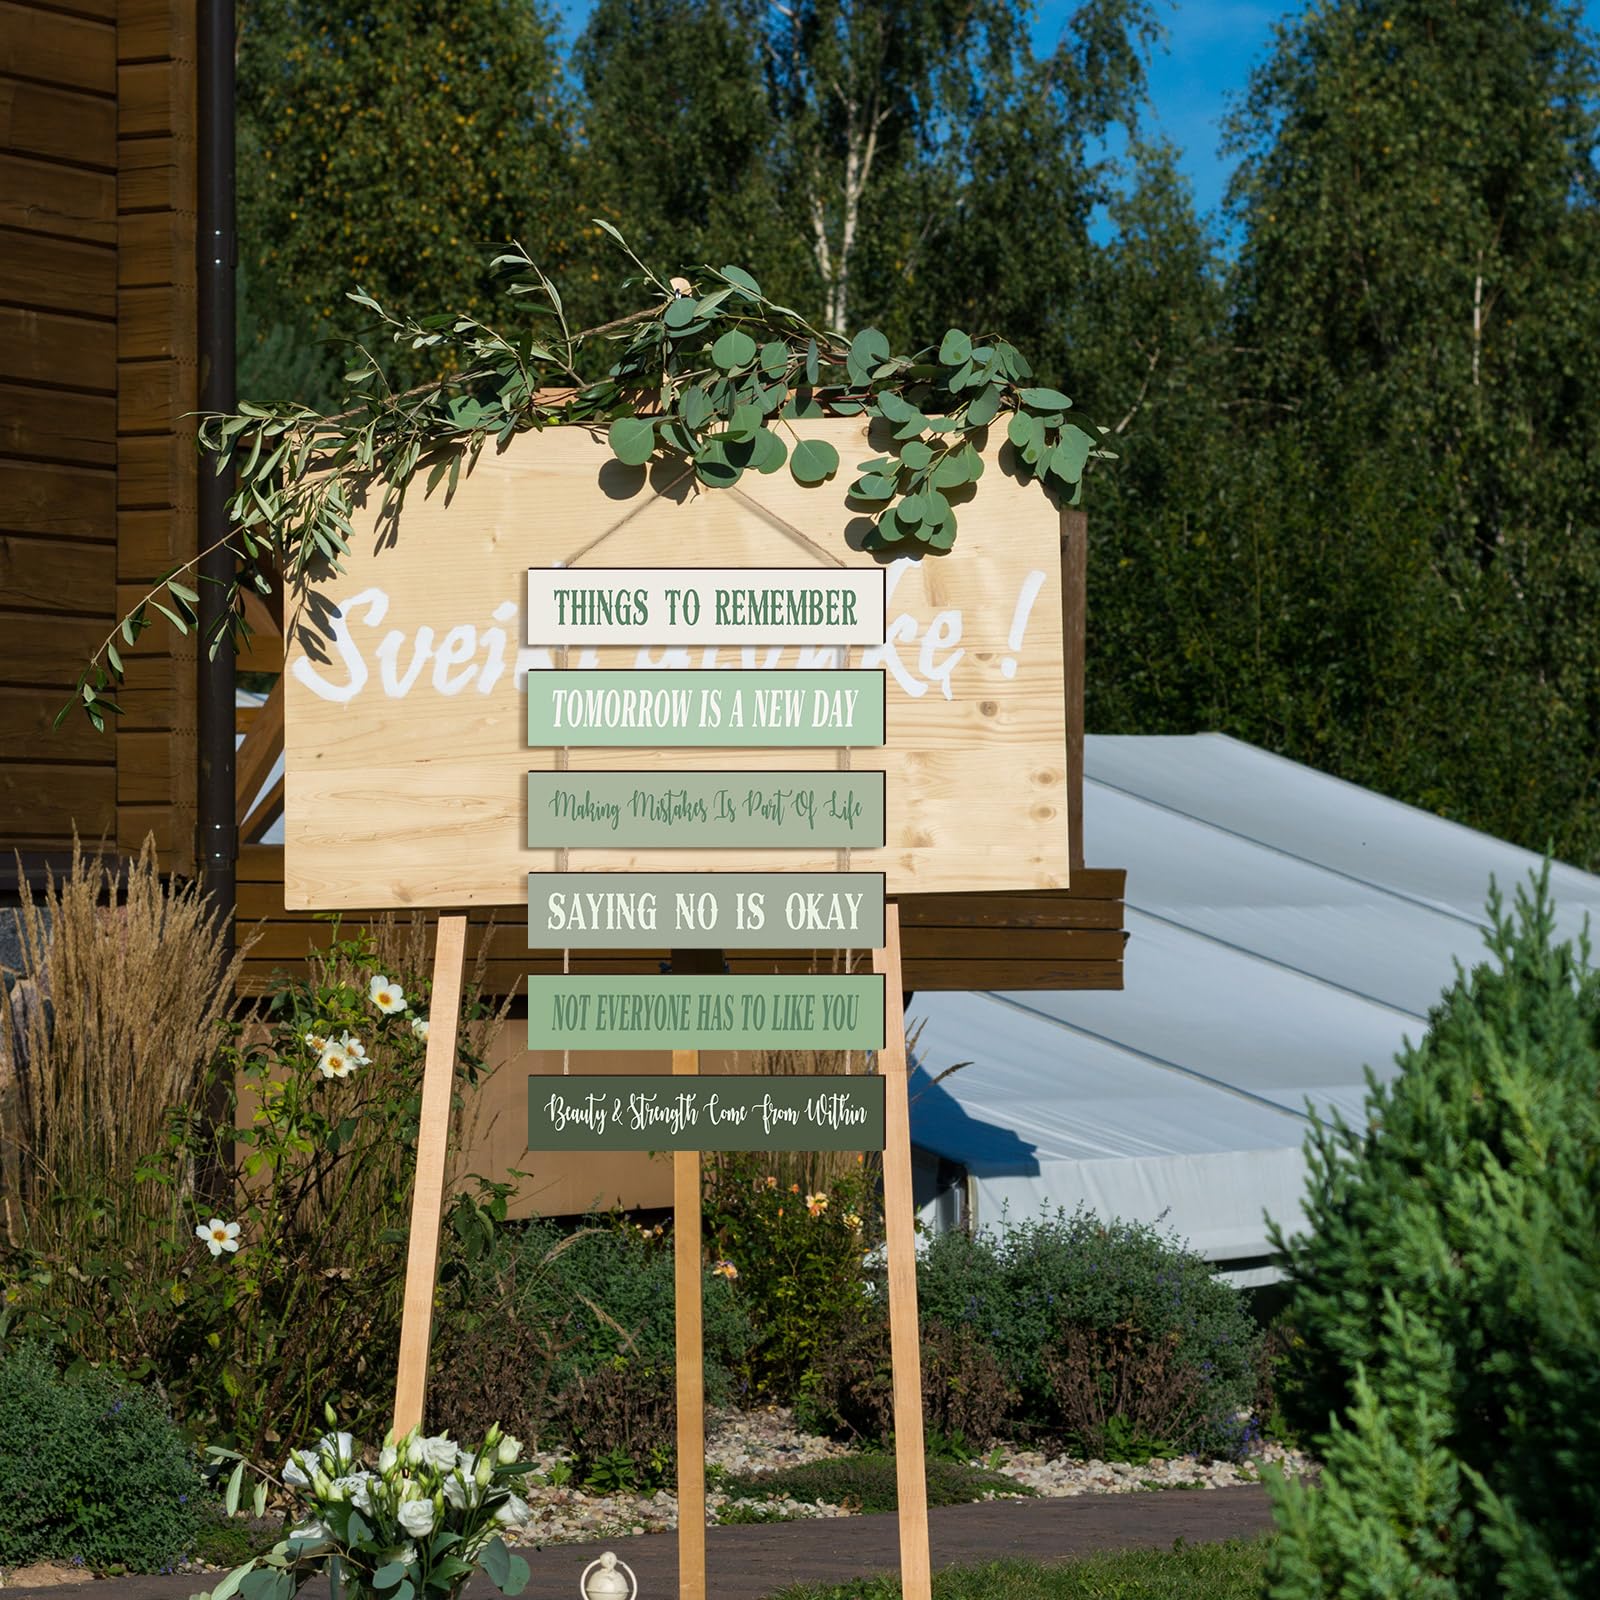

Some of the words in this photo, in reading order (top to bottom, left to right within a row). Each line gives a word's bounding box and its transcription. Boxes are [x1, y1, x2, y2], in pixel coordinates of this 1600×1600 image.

[553, 588, 649, 626] THINGS
[664, 588, 701, 626] TO
[714, 588, 858, 626] REMEMBER
[552, 688, 693, 728] TOMORROW
[699, 689, 722, 728] IS
[728, 689, 744, 728] A
[752, 689, 806, 728] NEW
[812, 689, 859, 728] DAY
[548, 790, 621, 830] Making
[627, 790, 708, 824] Mistakes
[713, 790, 736, 822] Is
[742, 790, 792, 826] Part
[791, 790, 817, 830] Of
[823, 790, 863, 830] Life
[547, 892, 657, 931] SAYING
[675, 892, 719, 930] NO
[736, 892, 766, 930] IS
[784, 892, 864, 930] OKAY
[552, 994, 591, 1031] NOT
[596, 994, 692, 1031] EVERYONE
[696, 994, 735, 1031] HAS
[741, 994, 766, 1031] TO
[771, 994, 815, 1031] LIKE
[822, 994, 859, 1031] YOU
[544, 1093, 607, 1135] Beauty
[611, 1097, 624, 1126] &
[626, 1093, 699, 1135] Strength
[703, 1093, 747, 1126] Come
[804, 1093, 867, 1131] Within
